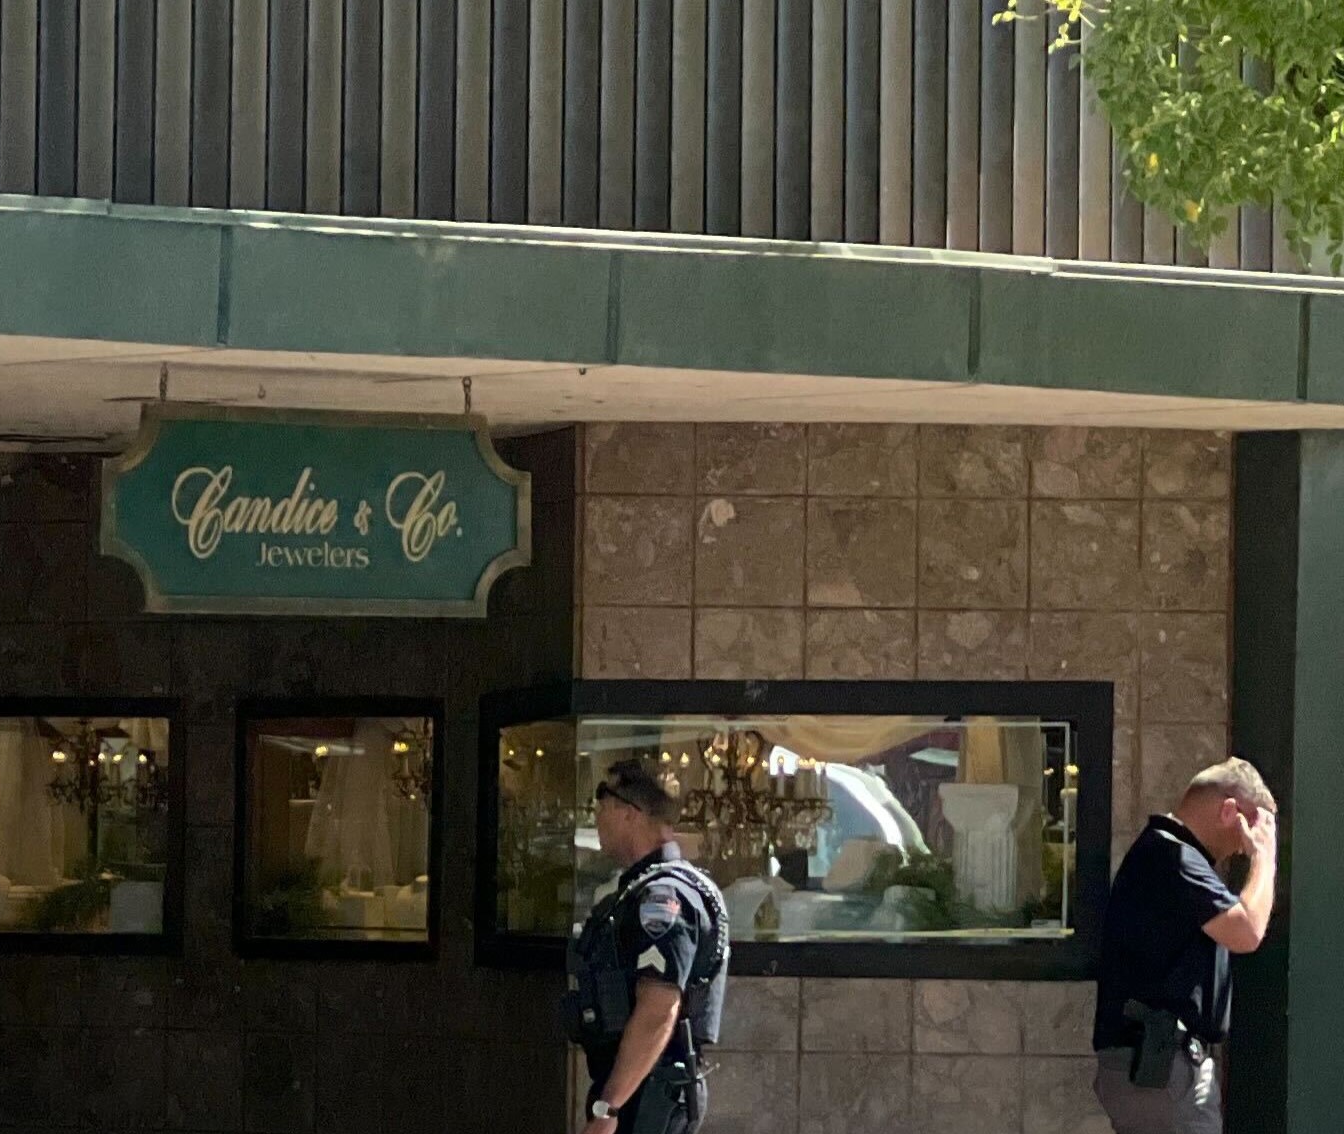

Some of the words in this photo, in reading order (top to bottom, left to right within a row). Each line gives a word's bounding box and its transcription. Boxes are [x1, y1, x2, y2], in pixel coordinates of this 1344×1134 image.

[172, 466, 339, 559] Candice
[354, 502, 372, 536] &
[385, 470, 463, 562] Co.
[256, 542, 370, 568] Jewelers
